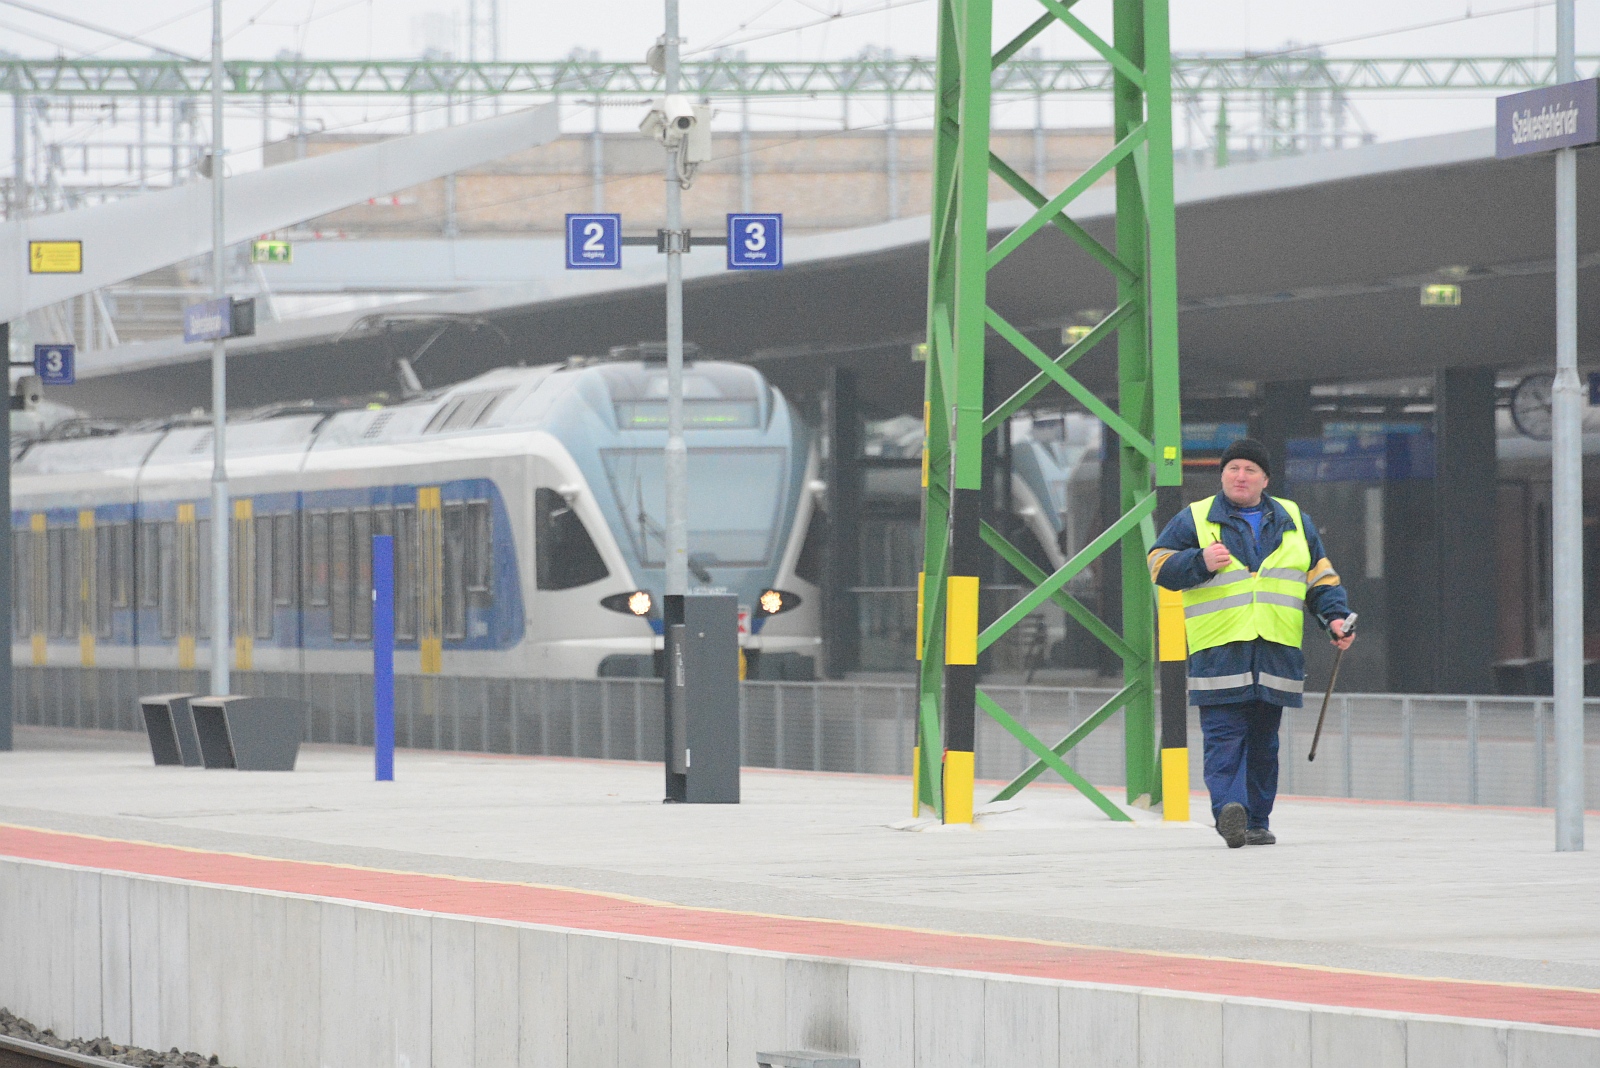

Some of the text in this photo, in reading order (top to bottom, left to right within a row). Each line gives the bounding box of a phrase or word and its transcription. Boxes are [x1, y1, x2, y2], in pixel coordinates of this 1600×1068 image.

[1511, 100, 1578, 145] Székesfehérvár
[583, 222, 604, 250] 2
[745, 222, 766, 251] 3
[46, 350, 62, 371] 3
